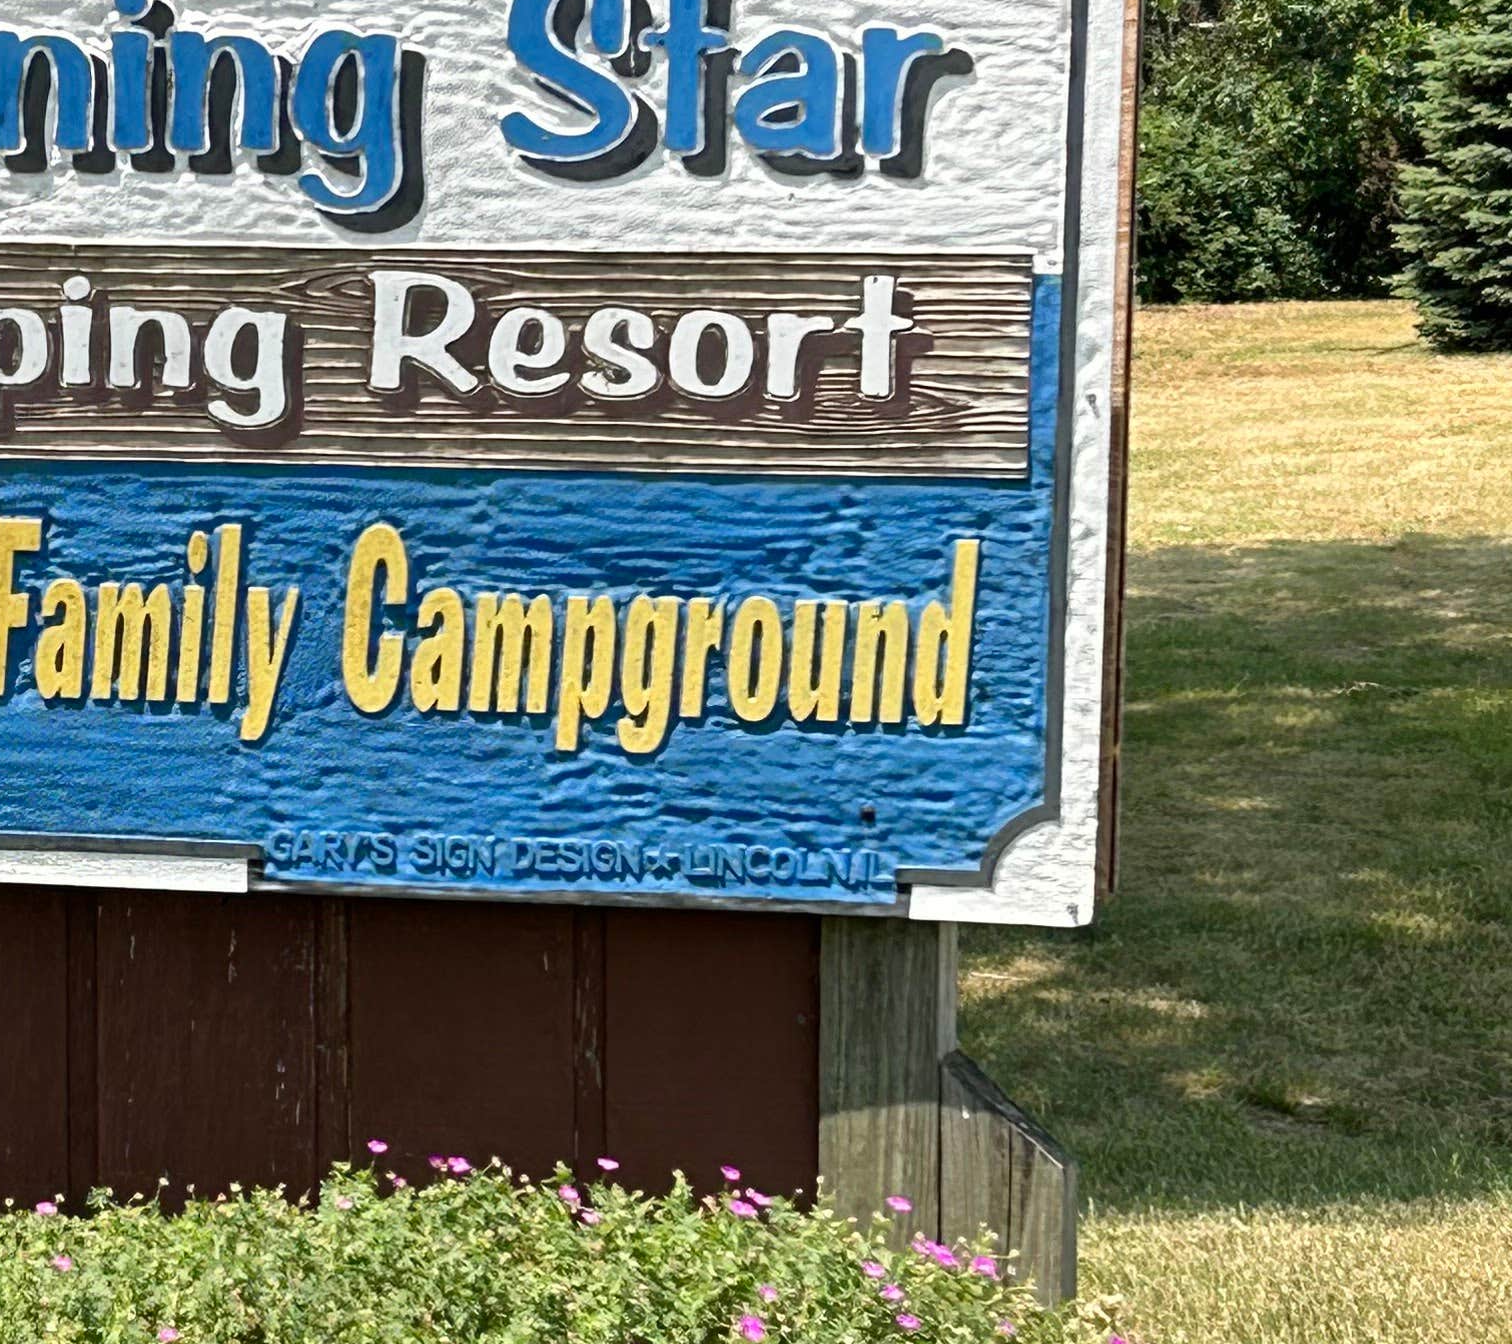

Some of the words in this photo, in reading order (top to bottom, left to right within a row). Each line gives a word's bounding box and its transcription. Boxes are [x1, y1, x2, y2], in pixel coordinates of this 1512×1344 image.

[366, 270, 912, 402] Resort
[341, 521, 980, 754] Campground
[268, 830, 394, 868] GARY'S
[408, 834, 496, 872] SIGN
[512, 836, 640, 875] DESIGN
